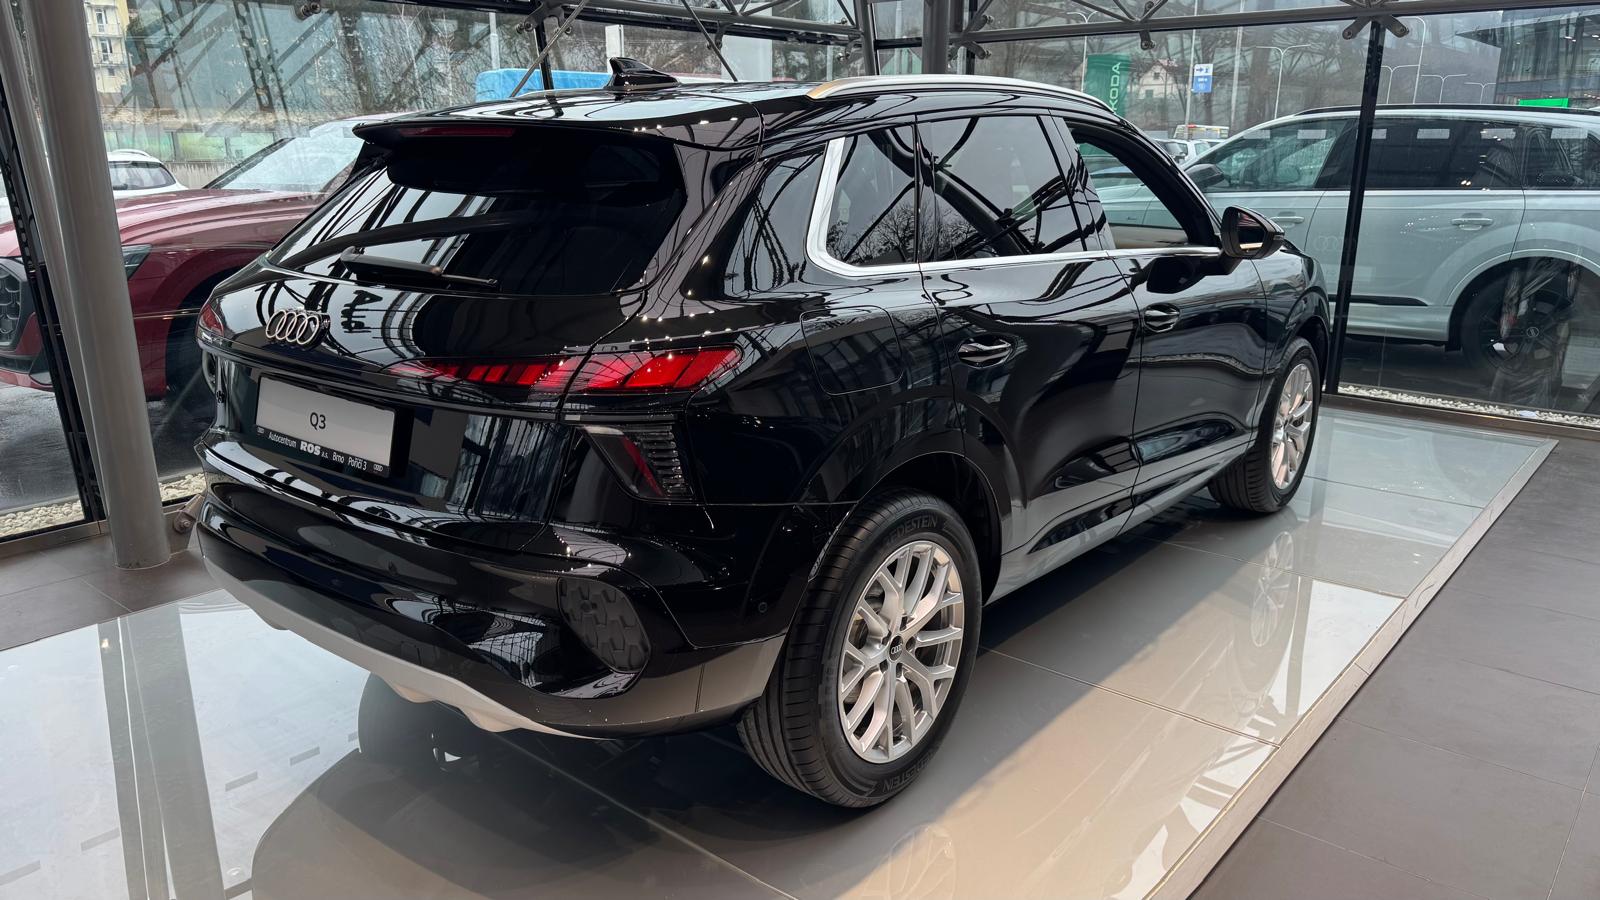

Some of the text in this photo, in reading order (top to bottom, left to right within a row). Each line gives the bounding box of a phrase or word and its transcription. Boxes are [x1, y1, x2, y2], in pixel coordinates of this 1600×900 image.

[1109, 62, 1121, 110] KODA
[310, 411, 326, 431] Q3
[269, 431, 297, 448] Autocentrum
[300, 440, 321, 456] ROS
[332, 451, 345, 464] Brno
[362, 460, 368, 471] 3
